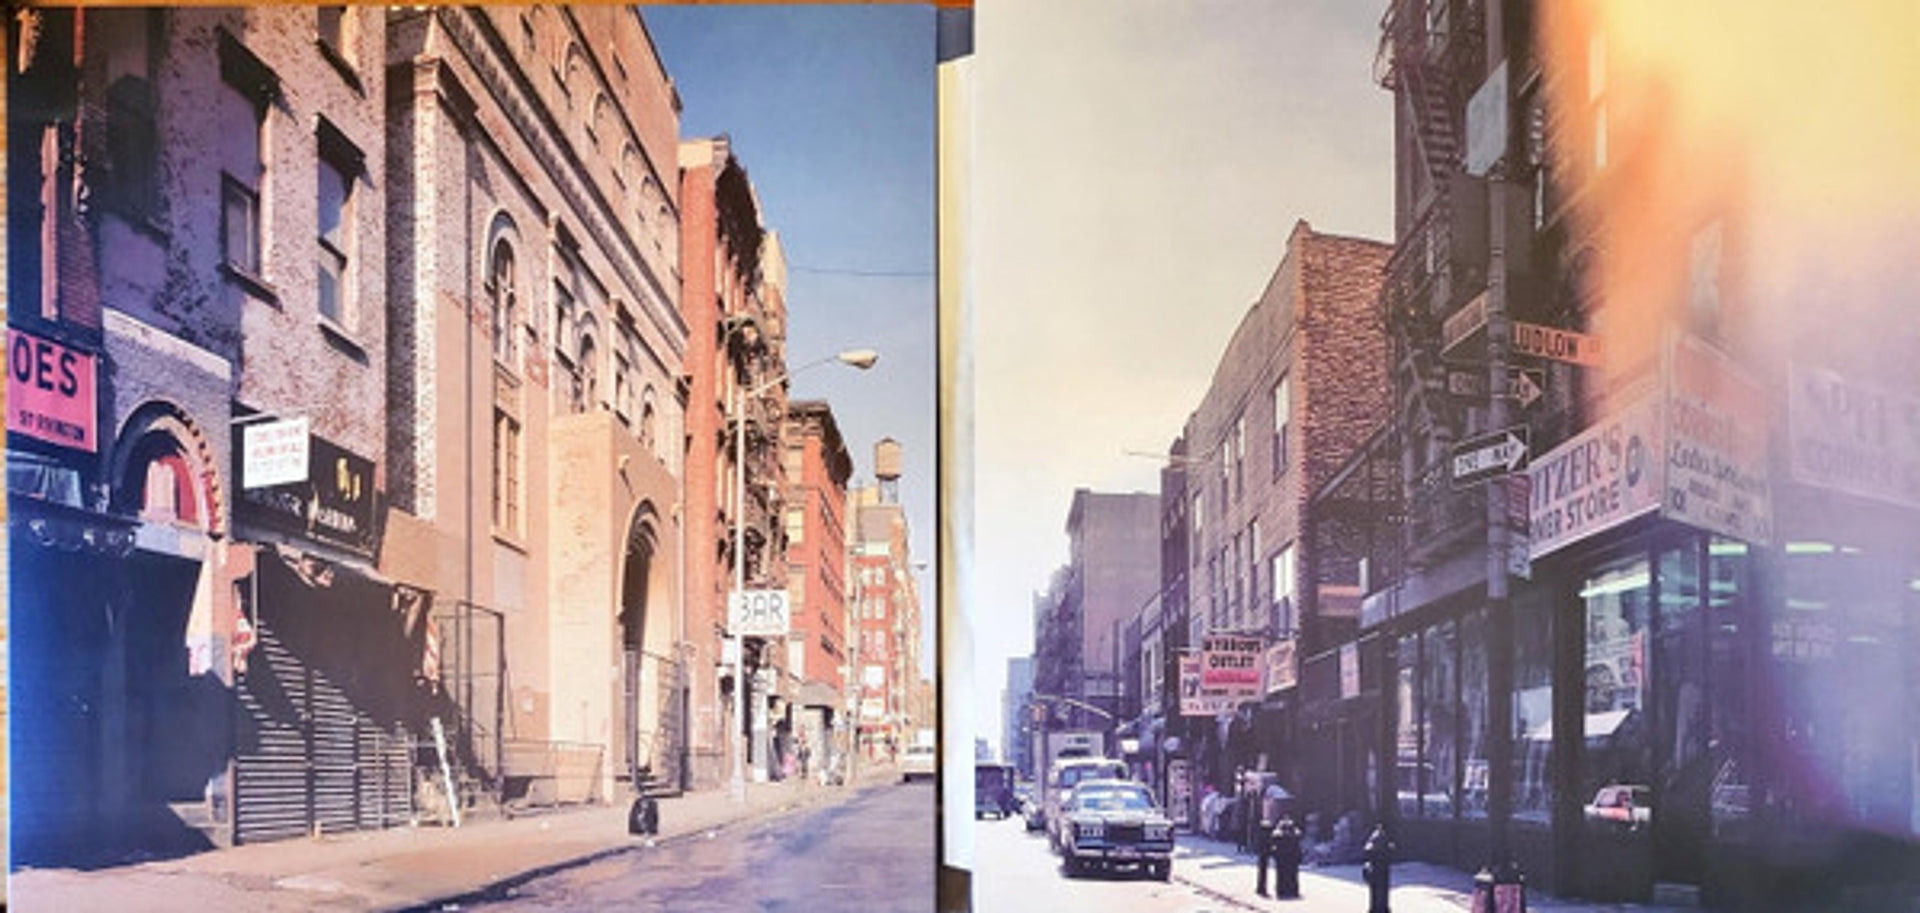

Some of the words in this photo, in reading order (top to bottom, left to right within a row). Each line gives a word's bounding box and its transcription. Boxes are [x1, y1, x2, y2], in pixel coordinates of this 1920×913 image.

[1513, 323, 1579, 359] LUDLOW
[13, 335, 78, 398] OES
[1567, 481, 1620, 531] STORE
